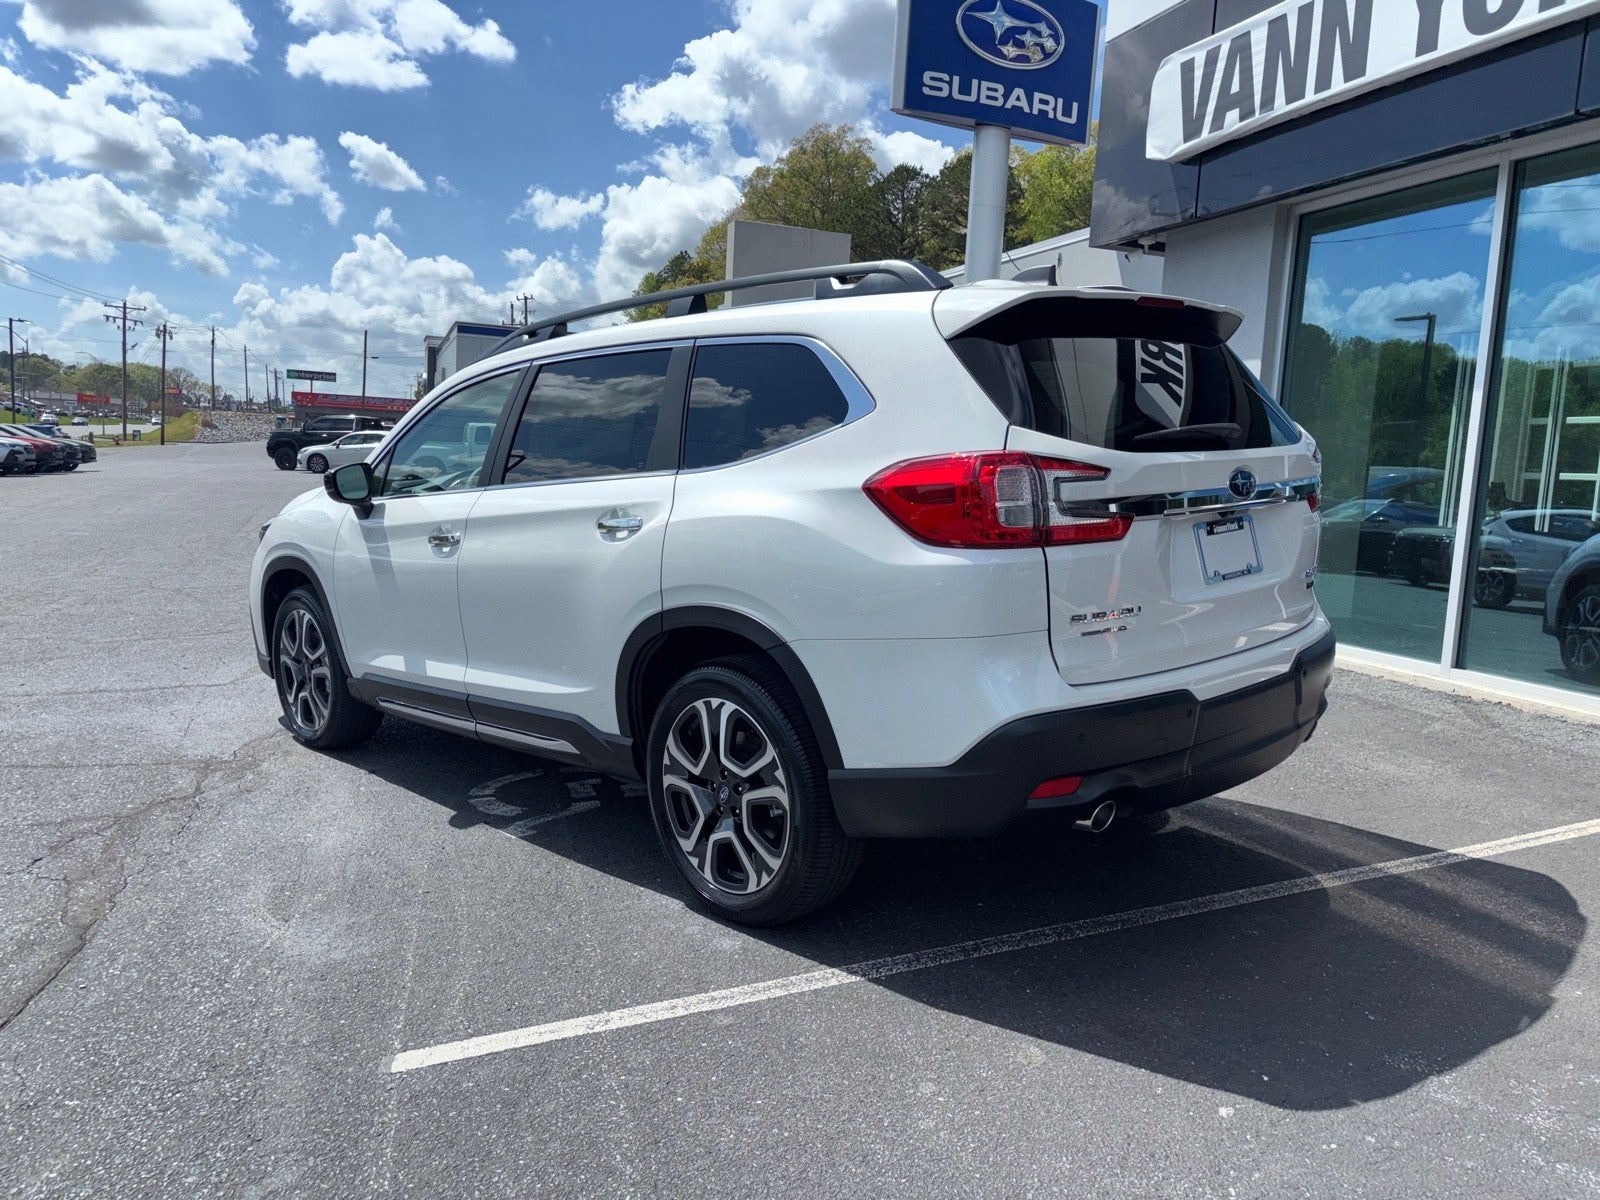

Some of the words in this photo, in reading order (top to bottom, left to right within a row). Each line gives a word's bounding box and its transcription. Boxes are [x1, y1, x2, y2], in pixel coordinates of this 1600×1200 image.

[921, 70, 1079, 125] SUBARU
[1180, 0, 1374, 145] VANN
[1069, 605, 1142, 626] SUBARU
